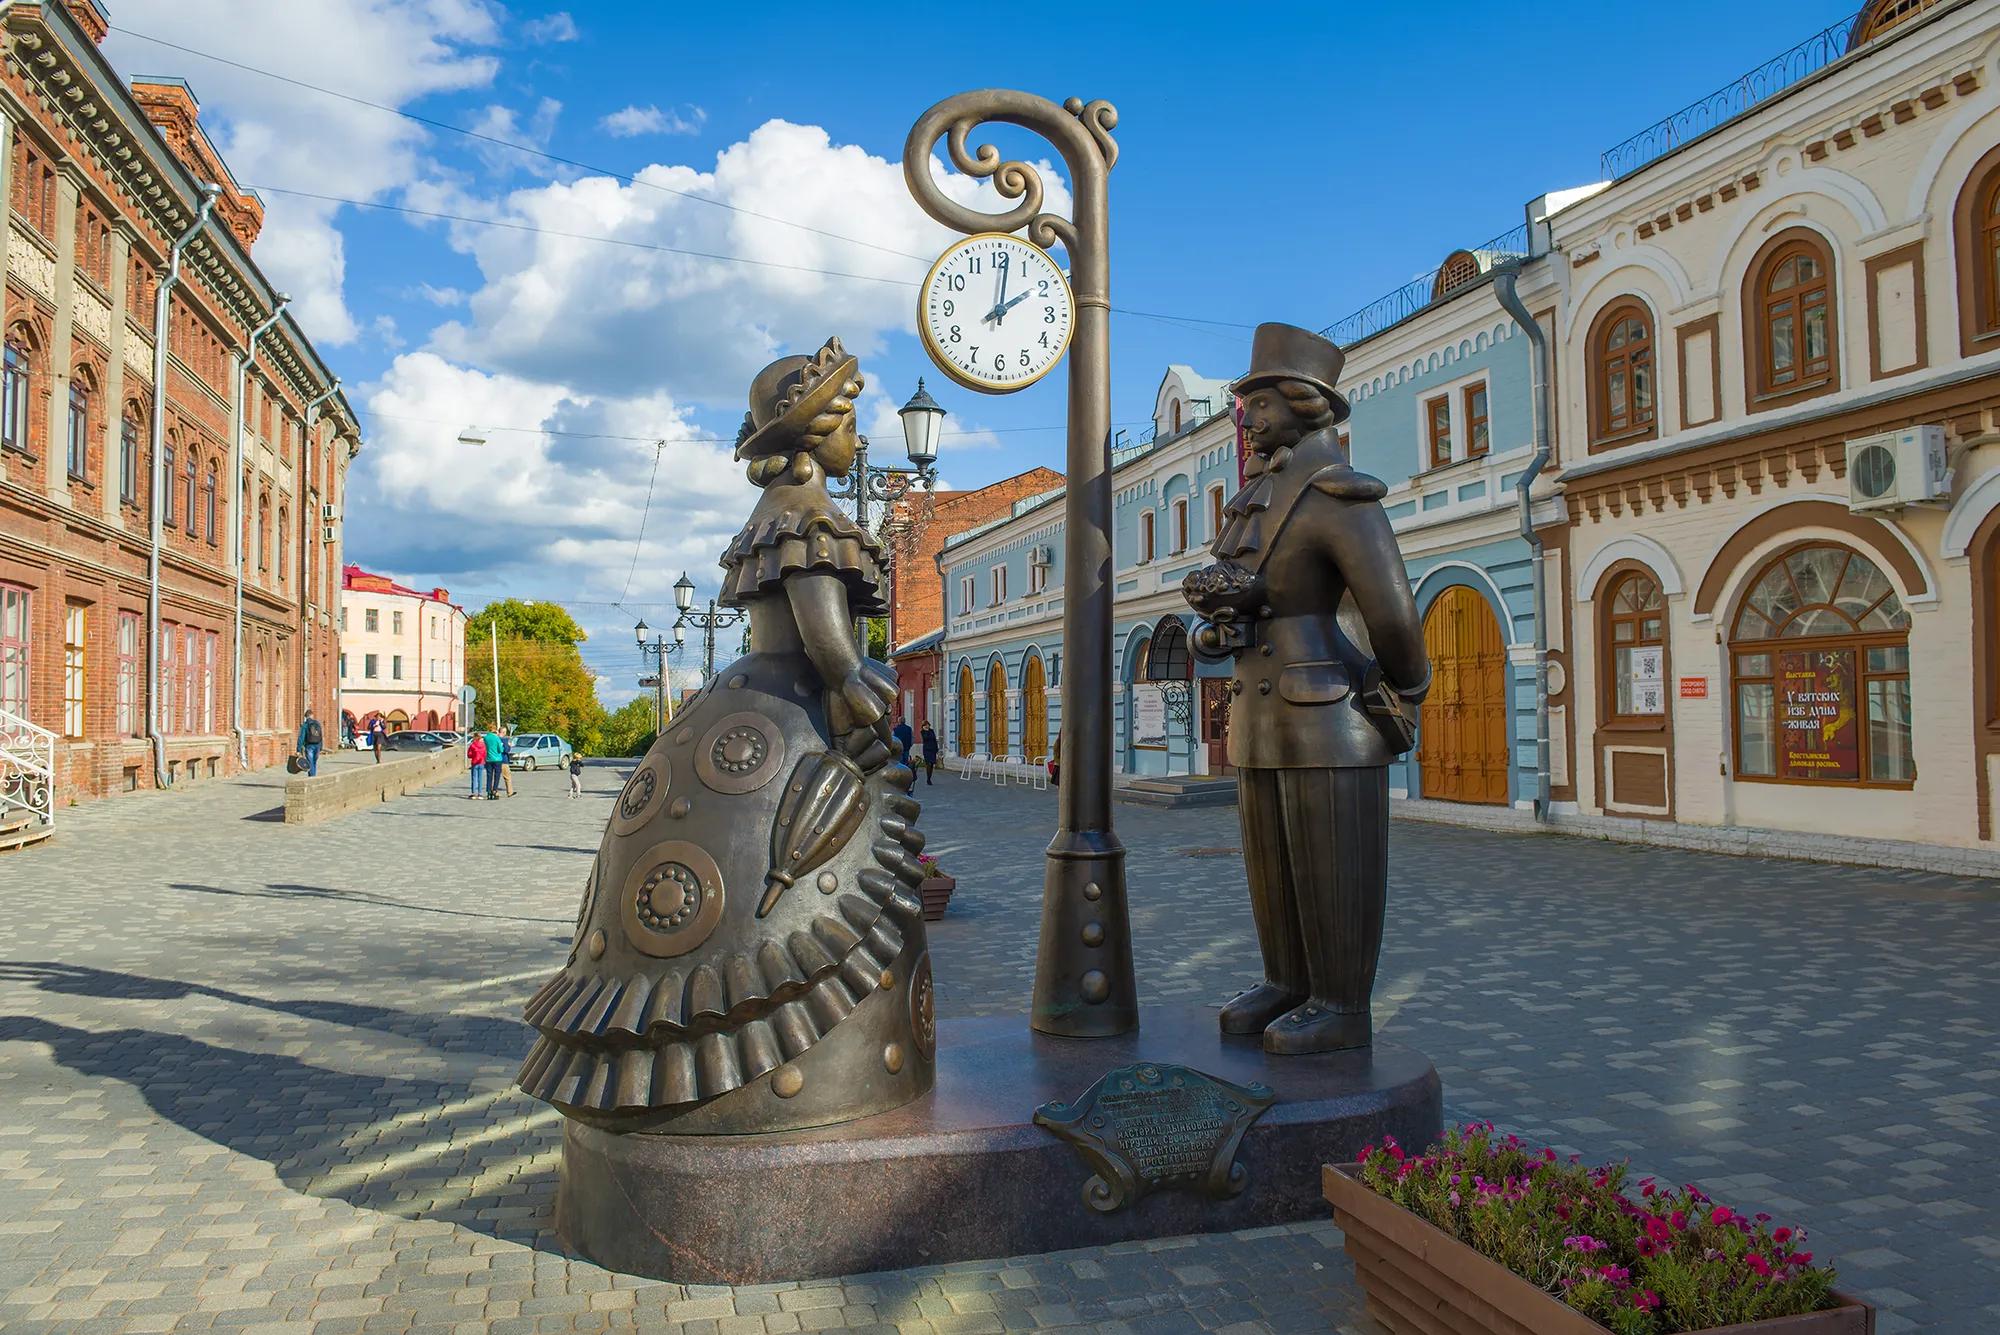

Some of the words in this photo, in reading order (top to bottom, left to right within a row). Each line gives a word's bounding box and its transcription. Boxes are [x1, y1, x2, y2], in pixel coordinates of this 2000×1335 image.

[969, 257, 981, 275] 11
[992, 251, 1009, 269] 12
[1021, 261, 1027, 277] 1
[947, 274, 965, 291] 10
[1038, 280, 1049, 298] 2
[943, 300, 955, 317] 9
[1044, 306, 1056, 323] 3
[950, 325, 962, 343] 8
[1038, 331, 1049, 348] 4
[969, 345, 980, 364] 7
[994, 354, 1005, 372] 6
[1019, 349, 1030, 367] 5
